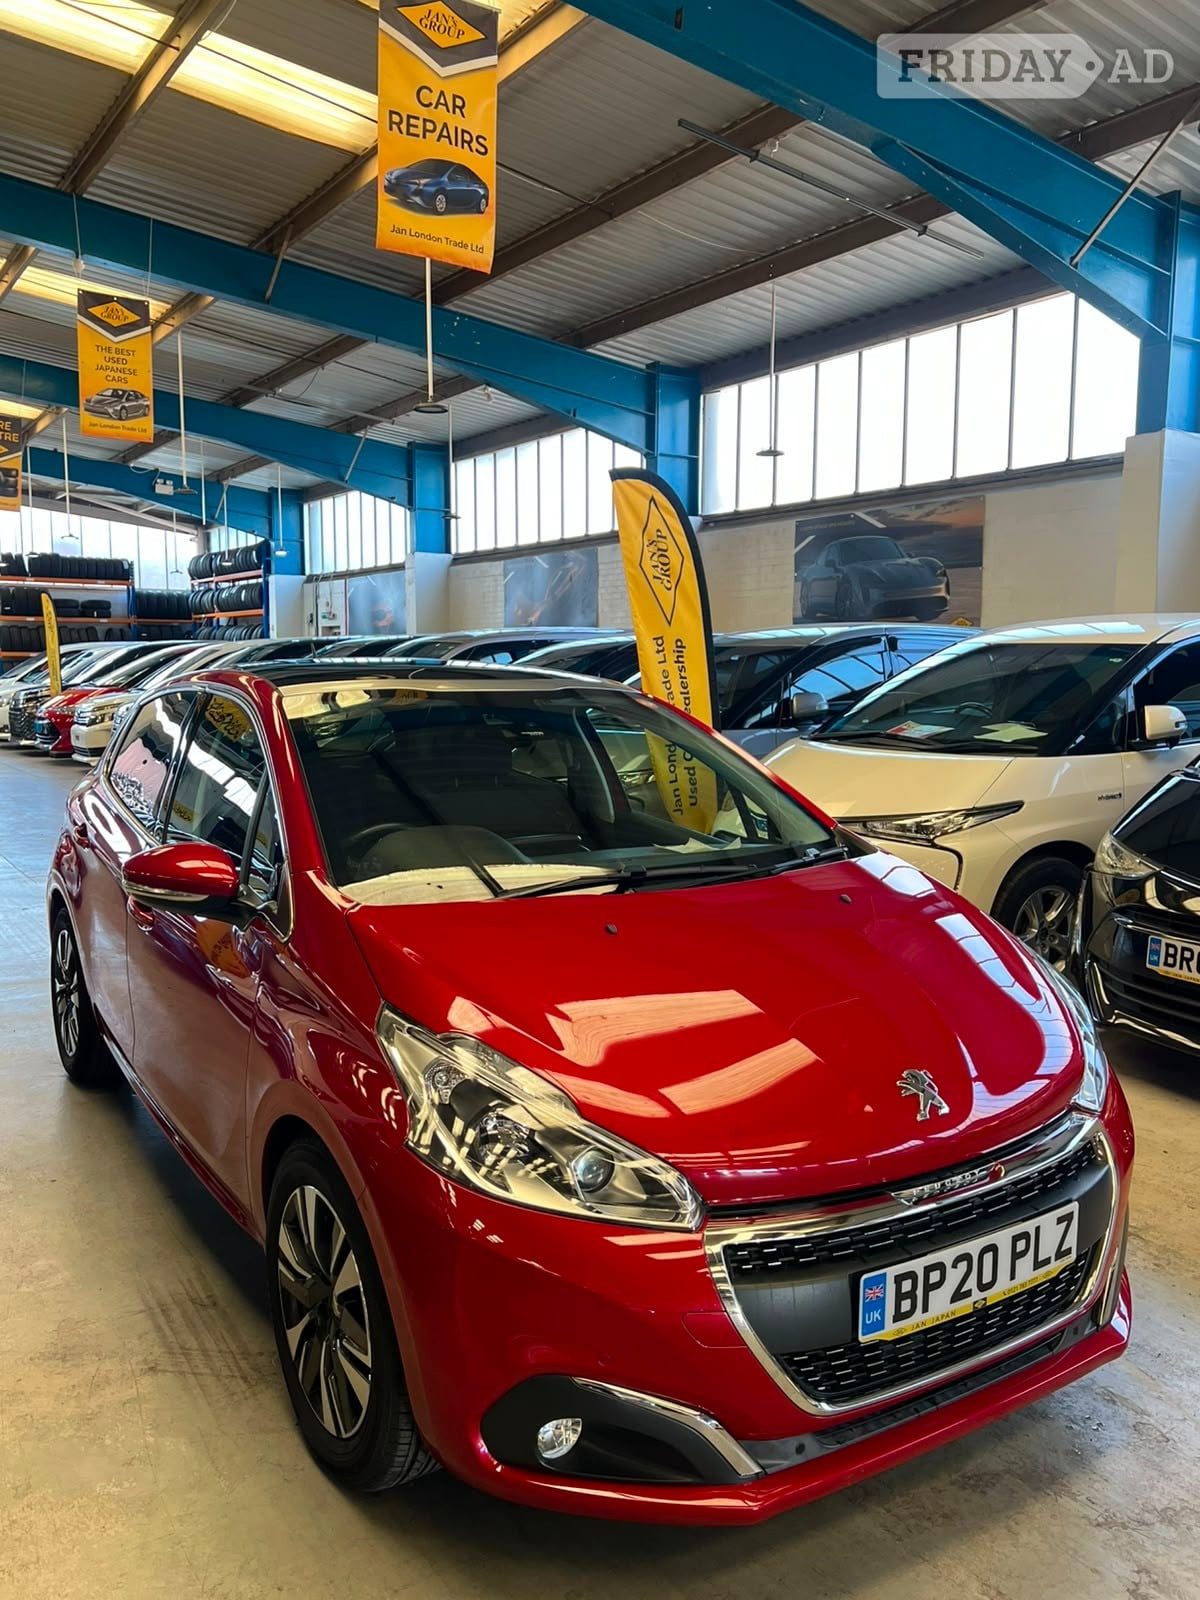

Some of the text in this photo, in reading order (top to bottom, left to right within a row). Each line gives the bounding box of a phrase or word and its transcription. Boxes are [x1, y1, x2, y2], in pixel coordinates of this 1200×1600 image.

[419, 18, 465, 39] GROUP
[424, 9, 458, 28] JAN'S
[416, 85, 466, 119] CAR
[388, 109, 488, 157] REPAIRS
[390, 224, 484, 254] Jan London Trade Ltd
[95, 345, 136, 357] THE BEST
[104, 356, 128, 365] USED
[95, 364, 138, 376] JAPANESE
[105, 374, 128, 384] CARS
[0, 421, 12, 431] RE
[656, 528, 673, 591] GROUP
[672, 638, 692, 714] ealership
[652, 635, 684, 816] Jan Lond ade Ltd
[684, 766, 699, 806] Used
[892, 1210, 1075, 1324] BP20 PLZ
[865, 1309, 881, 1324] UK
[911, 1321, 927, 1332] JAN
[930, 1310, 957, 1325] JAPAN
